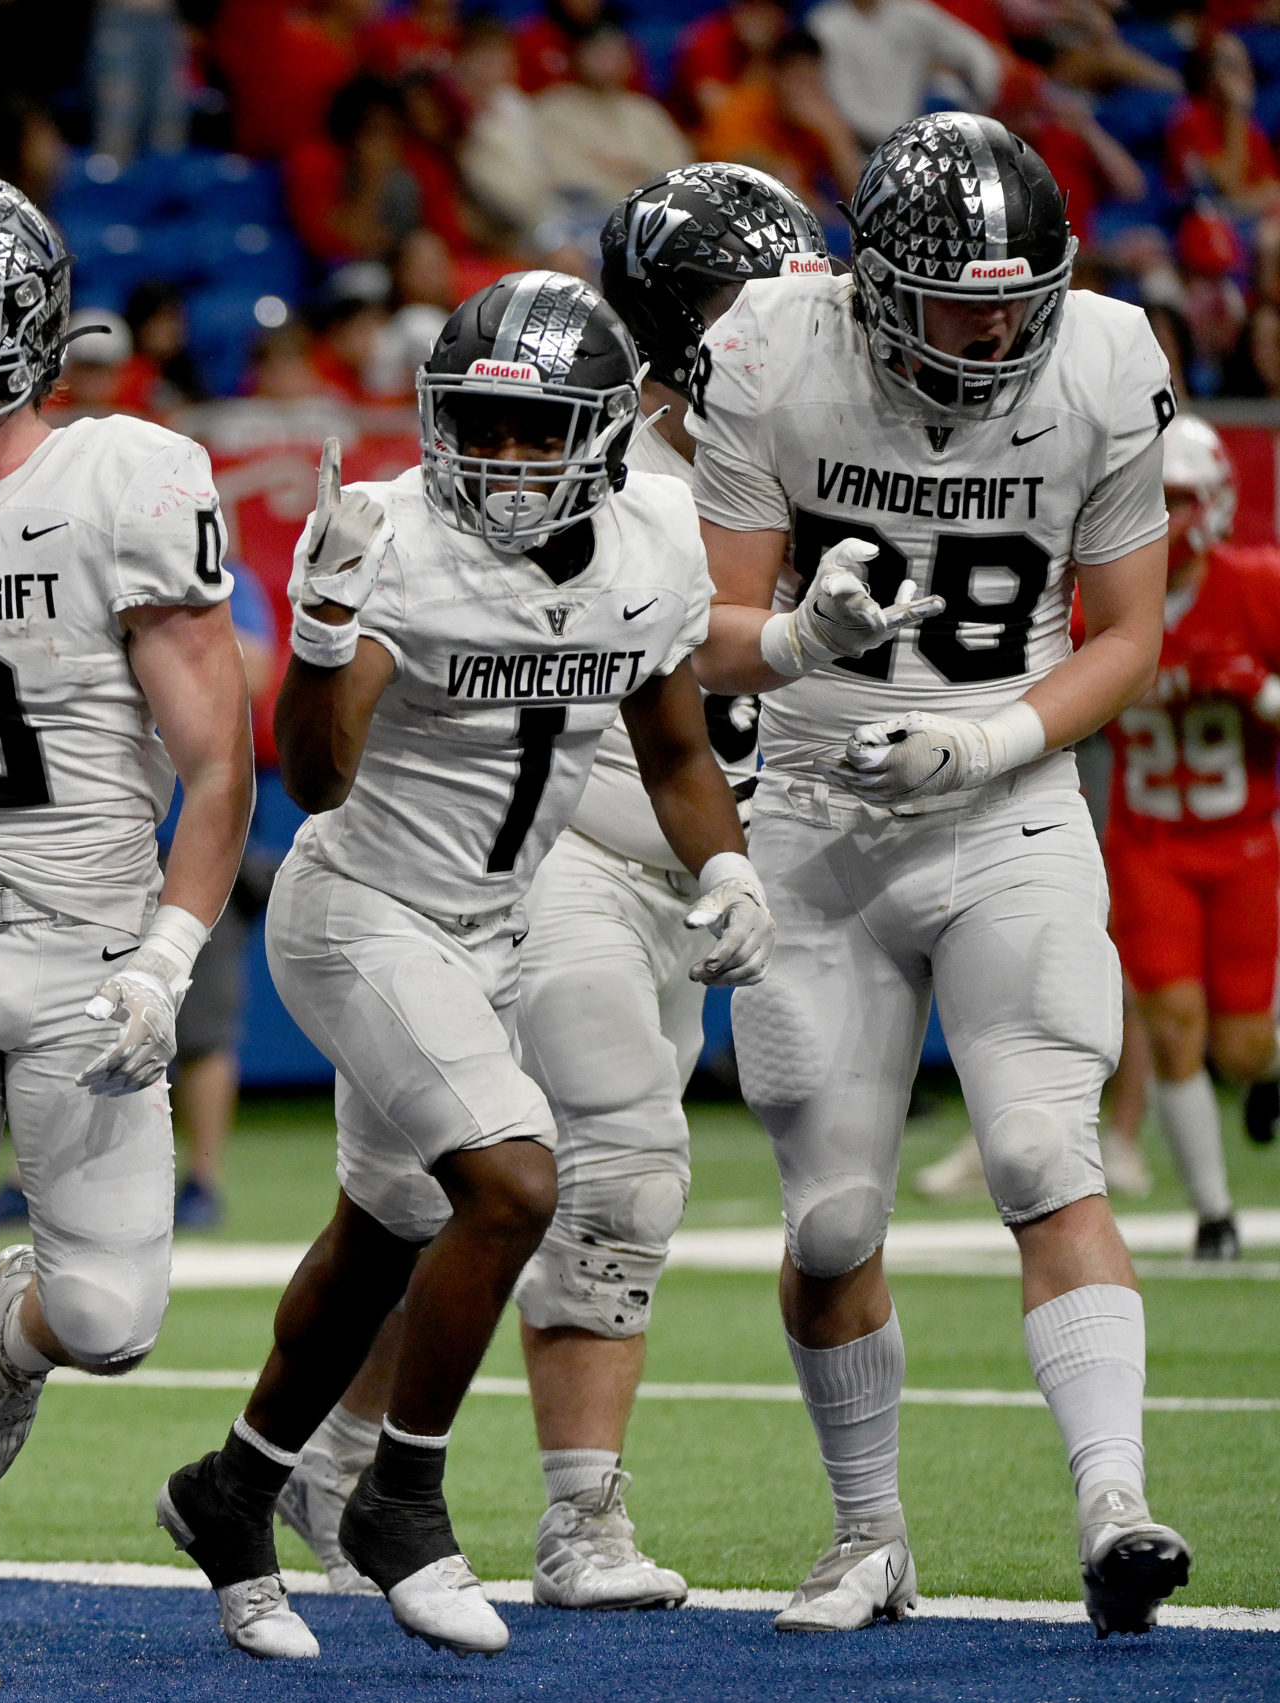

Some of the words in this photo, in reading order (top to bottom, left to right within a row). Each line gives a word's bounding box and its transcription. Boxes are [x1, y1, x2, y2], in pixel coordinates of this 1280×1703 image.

[790, 260, 829, 273] Riddell
[971, 264, 1025, 279] Riddell
[1027, 291, 1060, 334] Riddell
[475, 363, 531, 379] Riddell
[816, 458, 1044, 520] VANDEGRIFT
[447, 650, 645, 698] VANDEGRIFT
[1119, 700, 1248, 822] 29
[482, 704, 570, 879] 1
